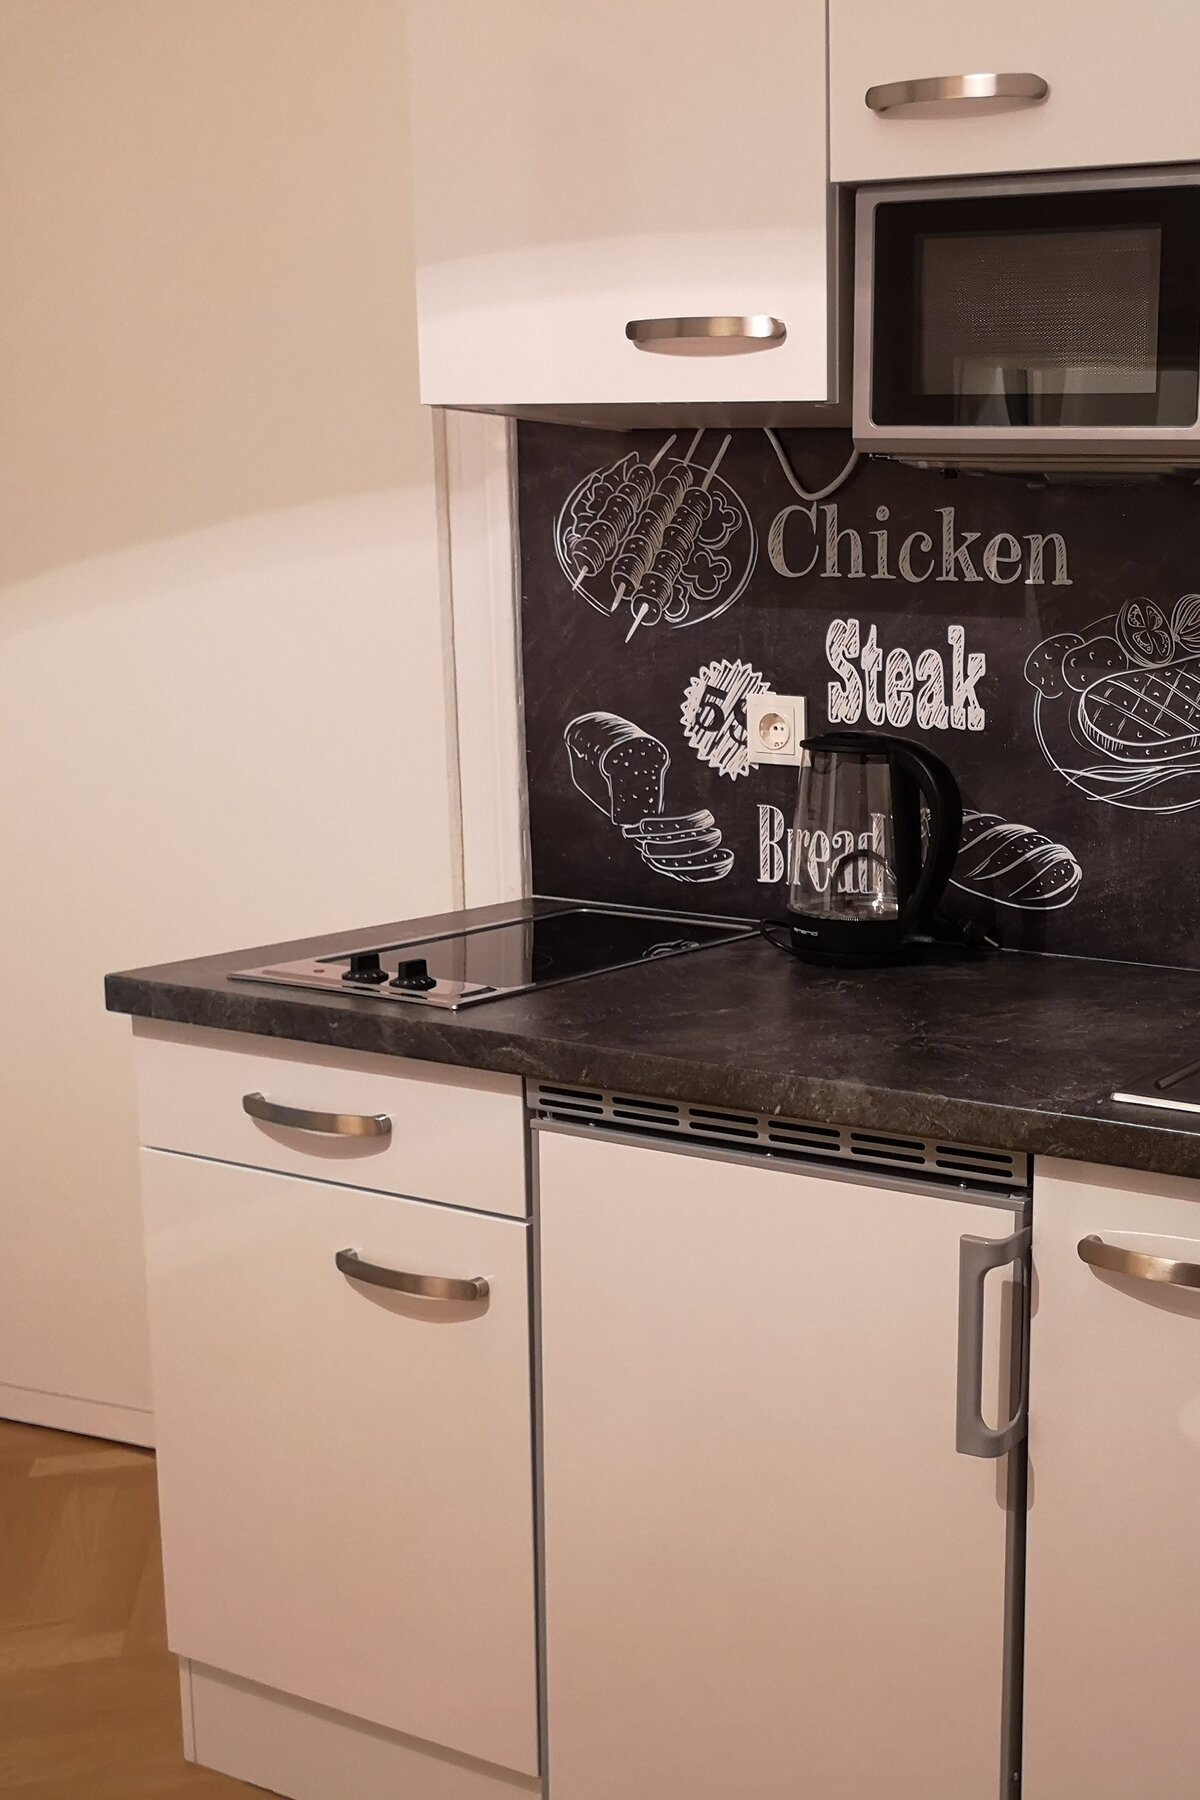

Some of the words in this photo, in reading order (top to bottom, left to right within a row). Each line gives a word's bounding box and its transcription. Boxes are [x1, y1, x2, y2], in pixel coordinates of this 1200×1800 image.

[767, 503, 1074, 586] Chicken
[825, 618, 987, 731] Steak
[757, 804, 886, 894] Bread
